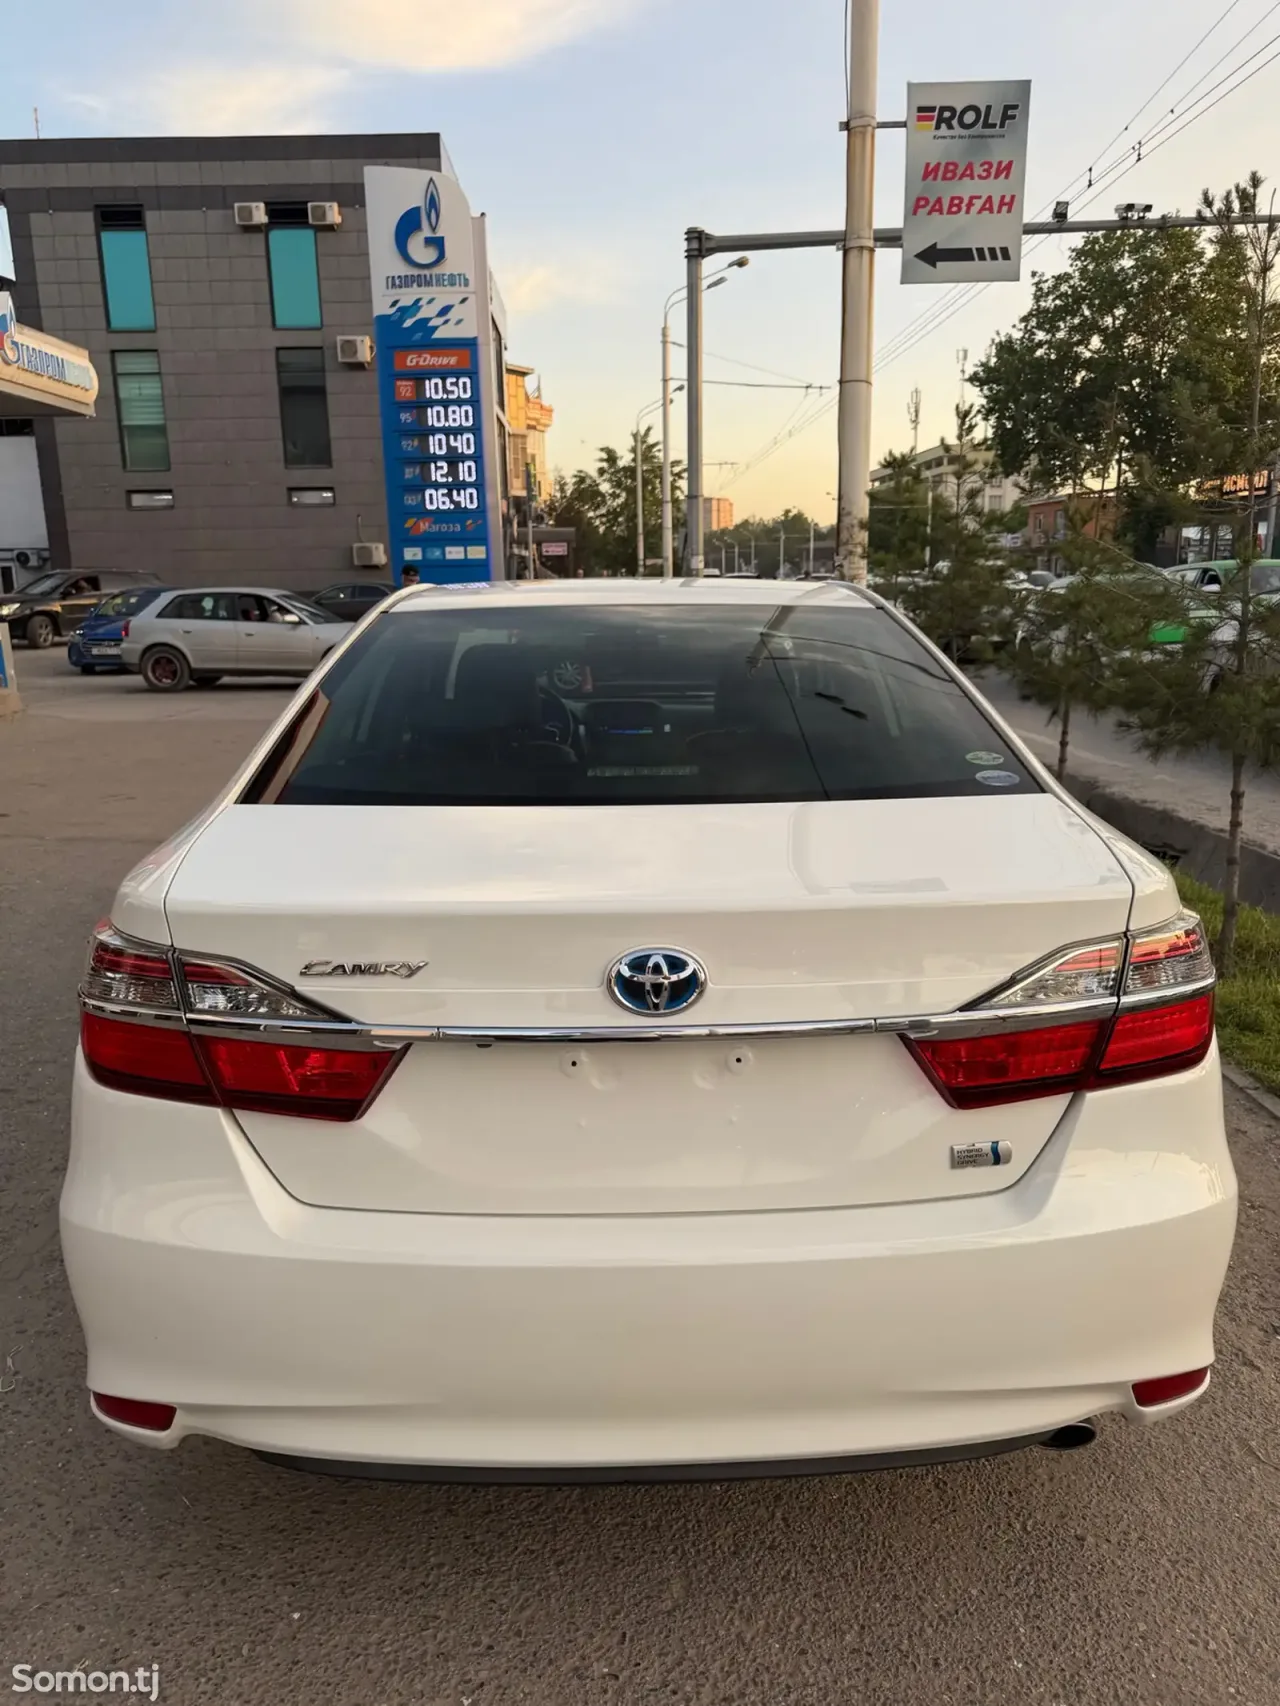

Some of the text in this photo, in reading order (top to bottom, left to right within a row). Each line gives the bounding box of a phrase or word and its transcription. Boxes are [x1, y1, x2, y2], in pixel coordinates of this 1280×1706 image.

[934, 104, 1019, 130] ROLF
[921, 160, 1014, 181] ИВАЗИ
[399, 376, 472, 399] 92 10.50
[427, 405, 474, 427] 10.80
[424, 487, 478, 510] 06.40
[299, 960, 430, 979] CAMRY
